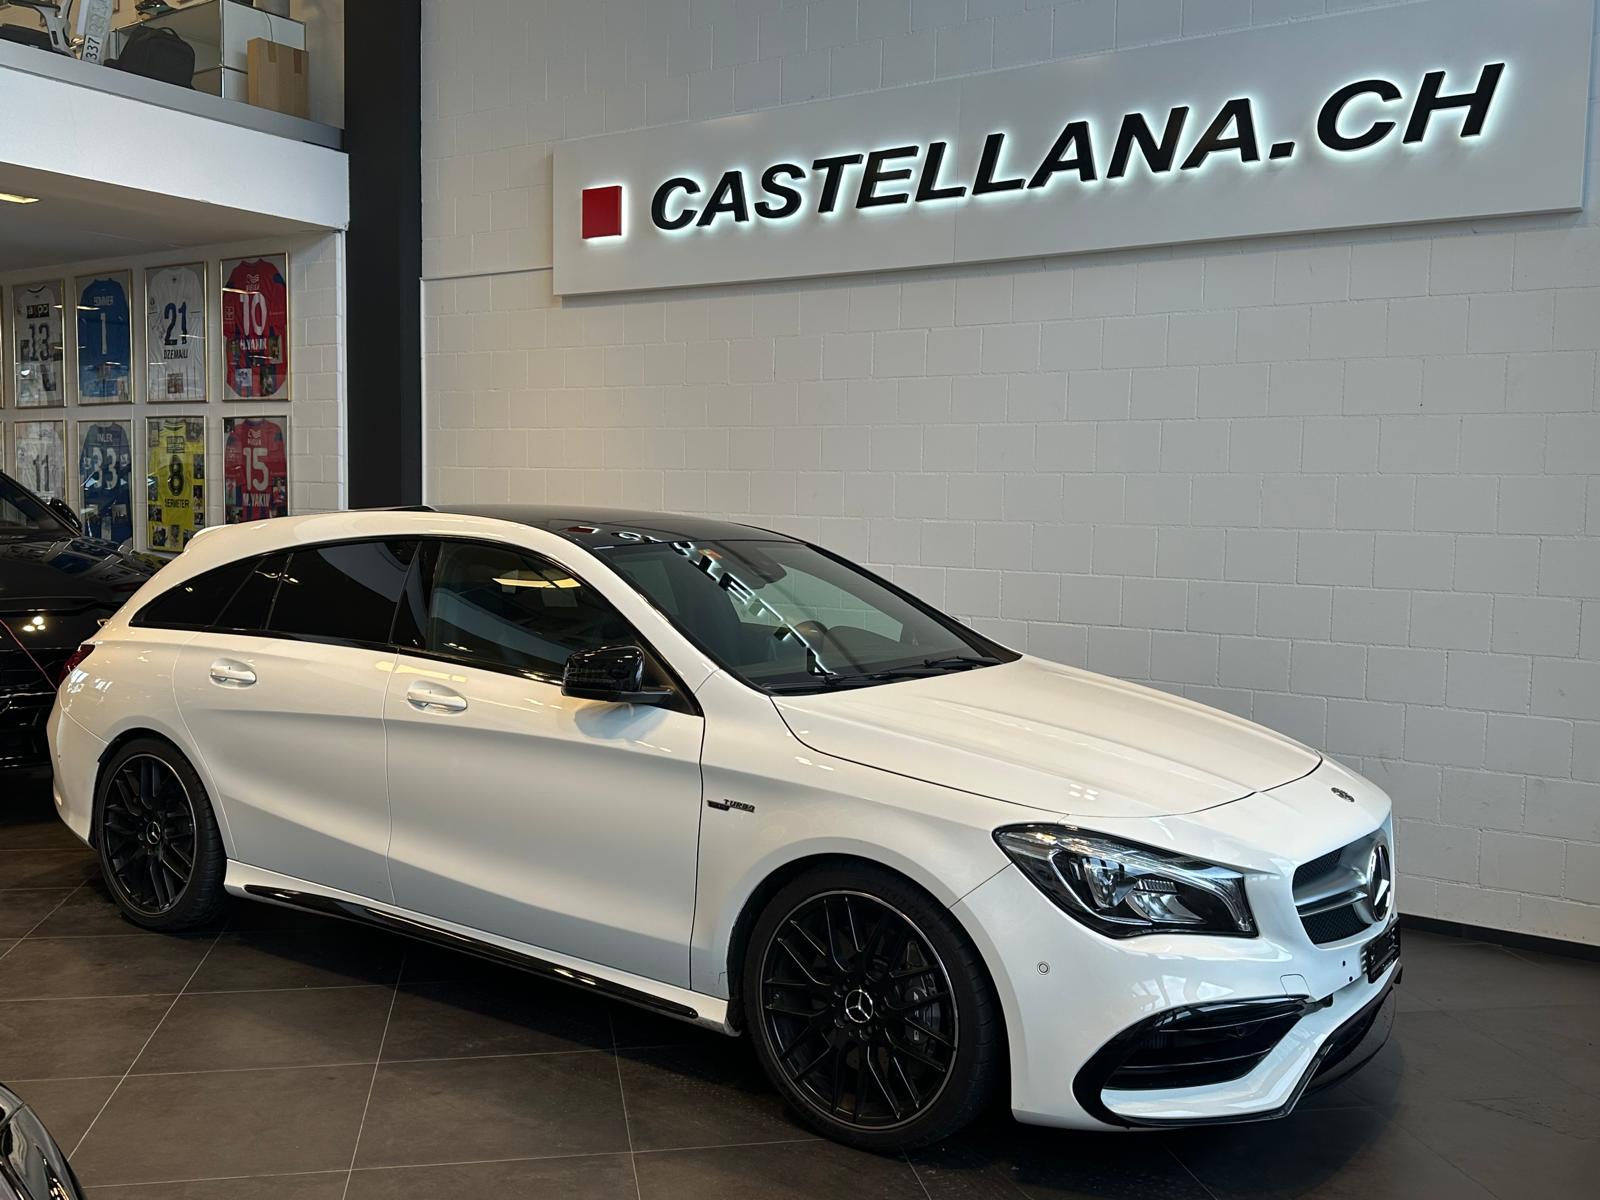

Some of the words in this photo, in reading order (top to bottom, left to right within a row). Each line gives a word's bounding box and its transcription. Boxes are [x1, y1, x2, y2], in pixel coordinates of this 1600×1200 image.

[651, 62, 1506, 231] CASTELLANA.CH
[100, 312, 107, 355] 1
[164, 301, 187, 346] 21
[240, 291, 268, 336] 10
[29, 322, 49, 361] 13
[32, 454, 50, 492] 11
[92, 447, 118, 490] 33
[168, 454, 184, 497] 8
[243, 447, 270, 491] 15
